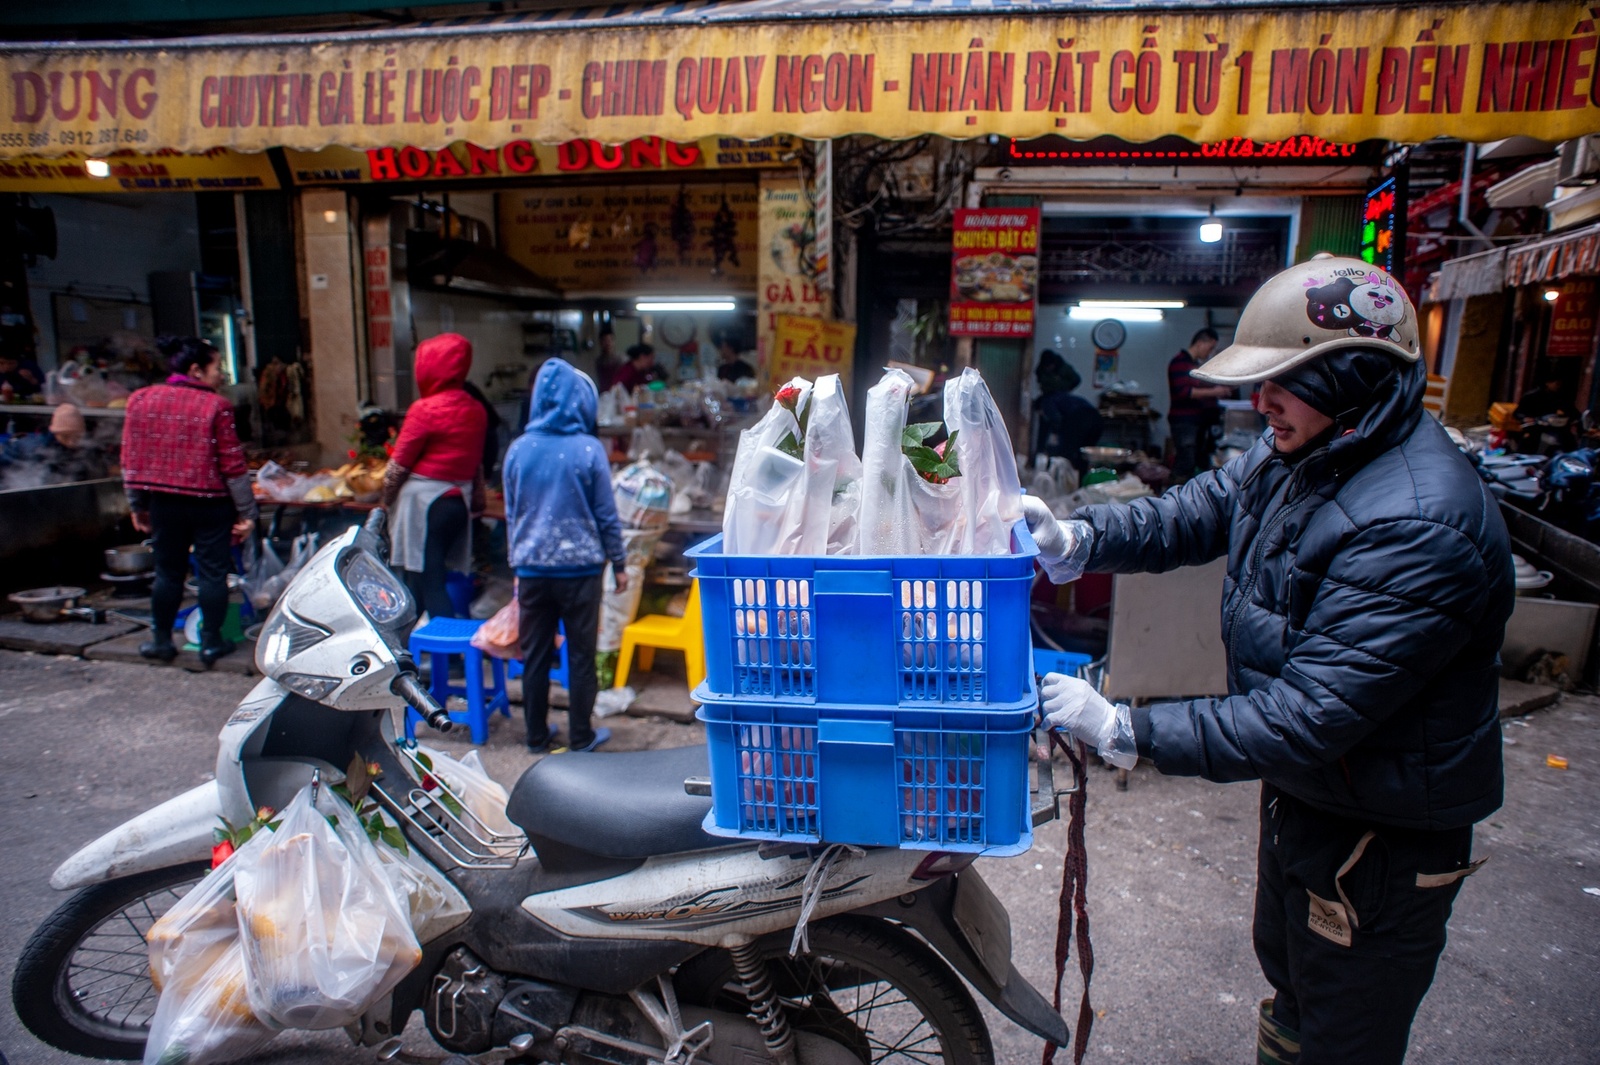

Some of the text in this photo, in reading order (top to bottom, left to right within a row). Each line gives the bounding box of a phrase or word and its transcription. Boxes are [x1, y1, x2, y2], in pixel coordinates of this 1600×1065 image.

[200, 61, 312, 129] CHUYÊN
[318, 59, 355, 127] GÀ
[489, 64, 551, 133] ĐẸP
[581, 59, 667, 120] CHIM
[675, 55, 766, 121] QUAY
[774, 52, 875, 114] NGON
[908, 38, 1015, 126] NHẬN
[1024, 38, 1100, 128] ĐẶT
[1109, 25, 1162, 115] CỖ
[1173, 33, 1229, 116] TỪ
[1235, 51, 1253, 115] 1
[1267, 33, 1370, 115] MÓN
[1375, 18, 1471, 116] ĐẾN
[11, 68, 159, 124] DUNG
[767, 278, 794, 303] GÀ
[1310, 918, 1344, 937] RE-NYLON
